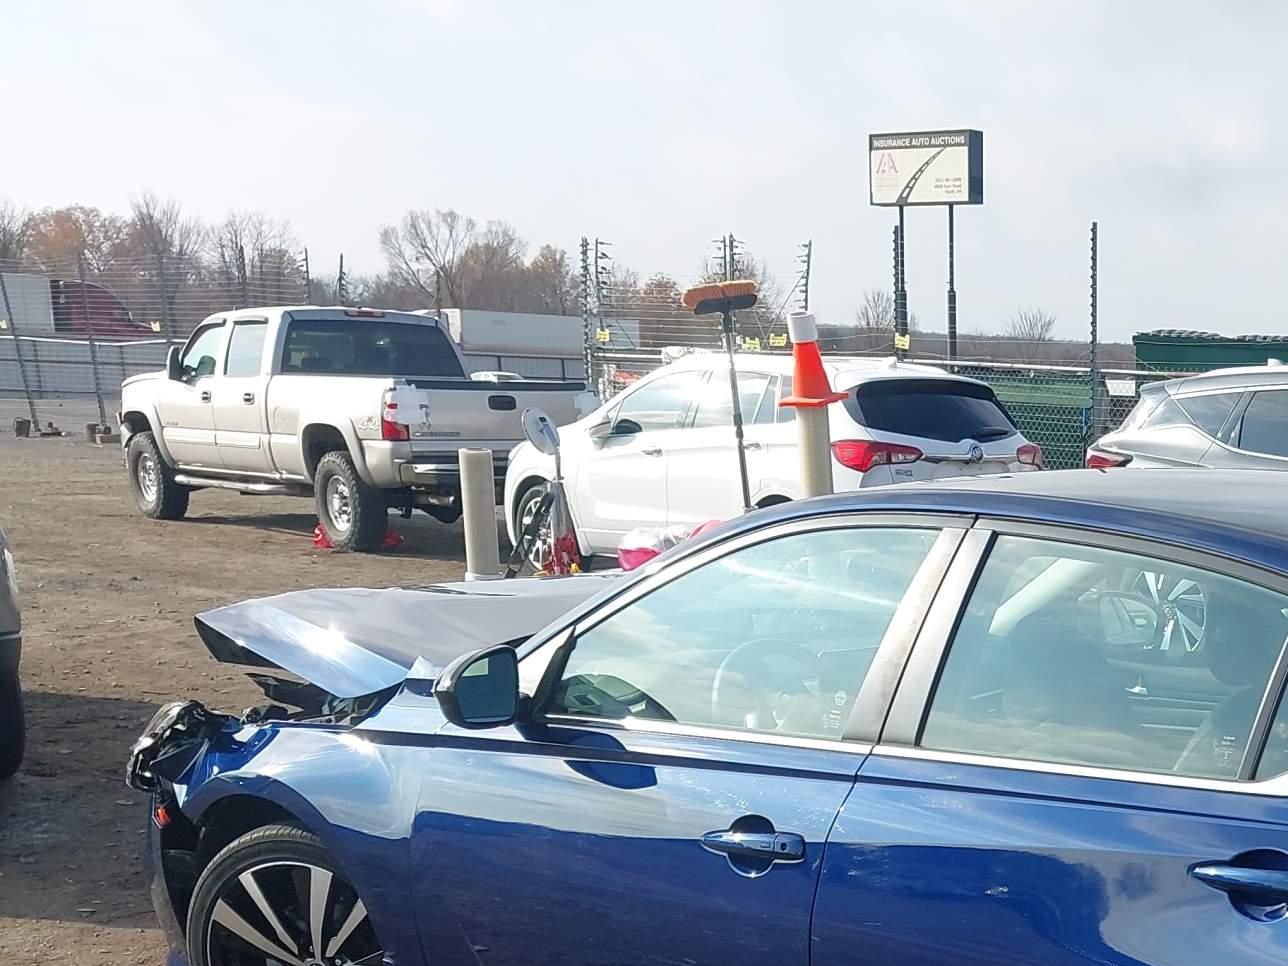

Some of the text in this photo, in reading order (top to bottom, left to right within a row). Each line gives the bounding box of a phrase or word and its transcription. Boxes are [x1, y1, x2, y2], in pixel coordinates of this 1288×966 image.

[873, 135, 965, 148] INSURANCE AUTO AUCTIONS
